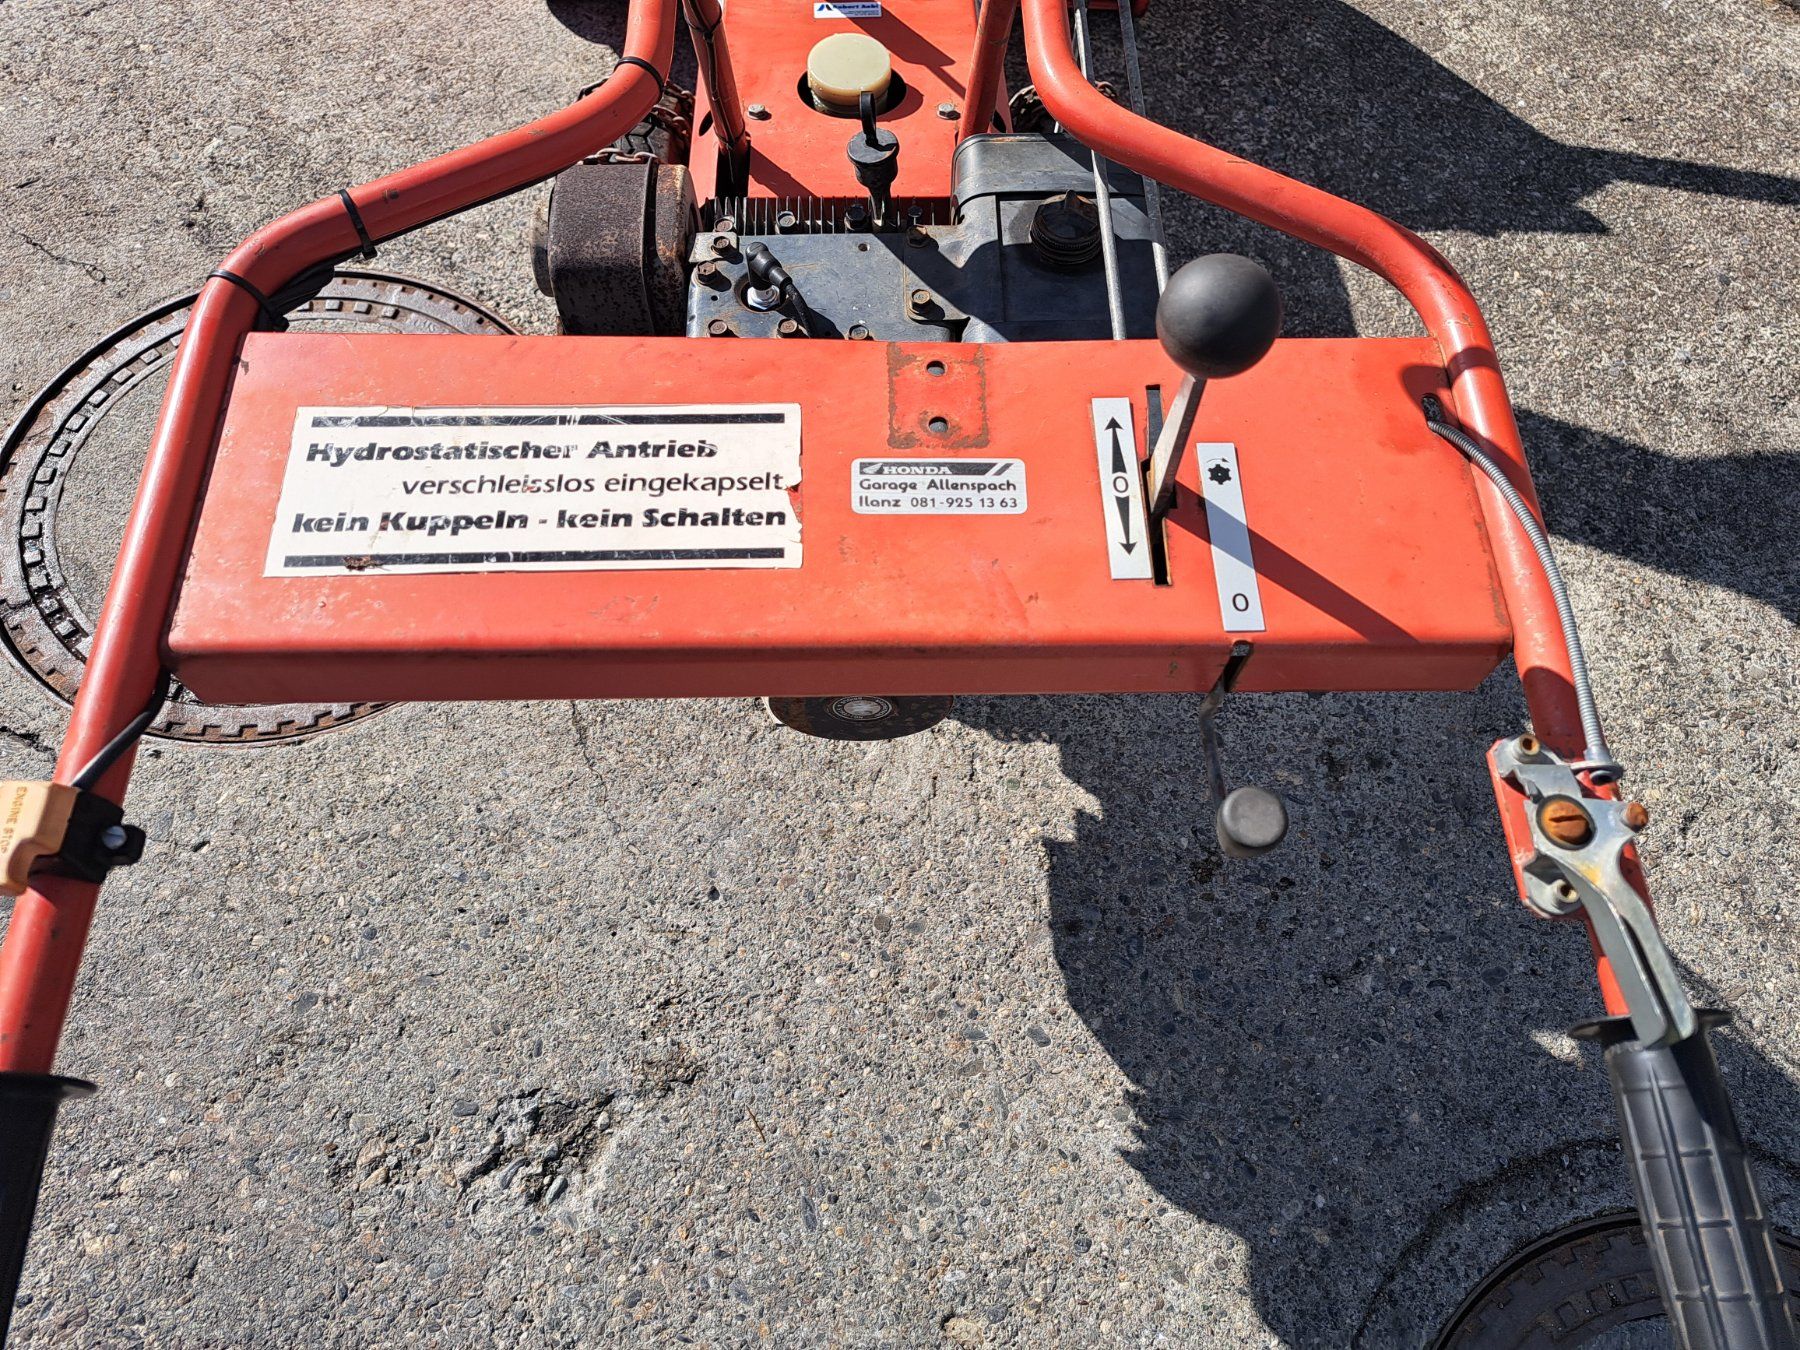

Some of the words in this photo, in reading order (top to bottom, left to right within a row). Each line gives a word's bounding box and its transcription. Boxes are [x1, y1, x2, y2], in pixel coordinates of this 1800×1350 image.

[305, 442, 578, 467] Hydrostatischer
[586, 440, 719, 459] Antrieb
[882, 466, 952, 475] HONDA
[402, 473, 596, 495] verschleisslos
[859, 479, 918, 493] Garage
[926, 478, 1017, 494] Allenspach
[859, 496, 902, 508] Ilanz
[981, 497, 995, 508] 13
[1000, 497, 1018, 508] 63
[292, 512, 368, 533] kein
[380, 511, 529, 537] Kuppeln
[557, 509, 634, 528] kein
[642, 506, 787, 529] Schalten
[6, 786, 27, 824] ENGINE
